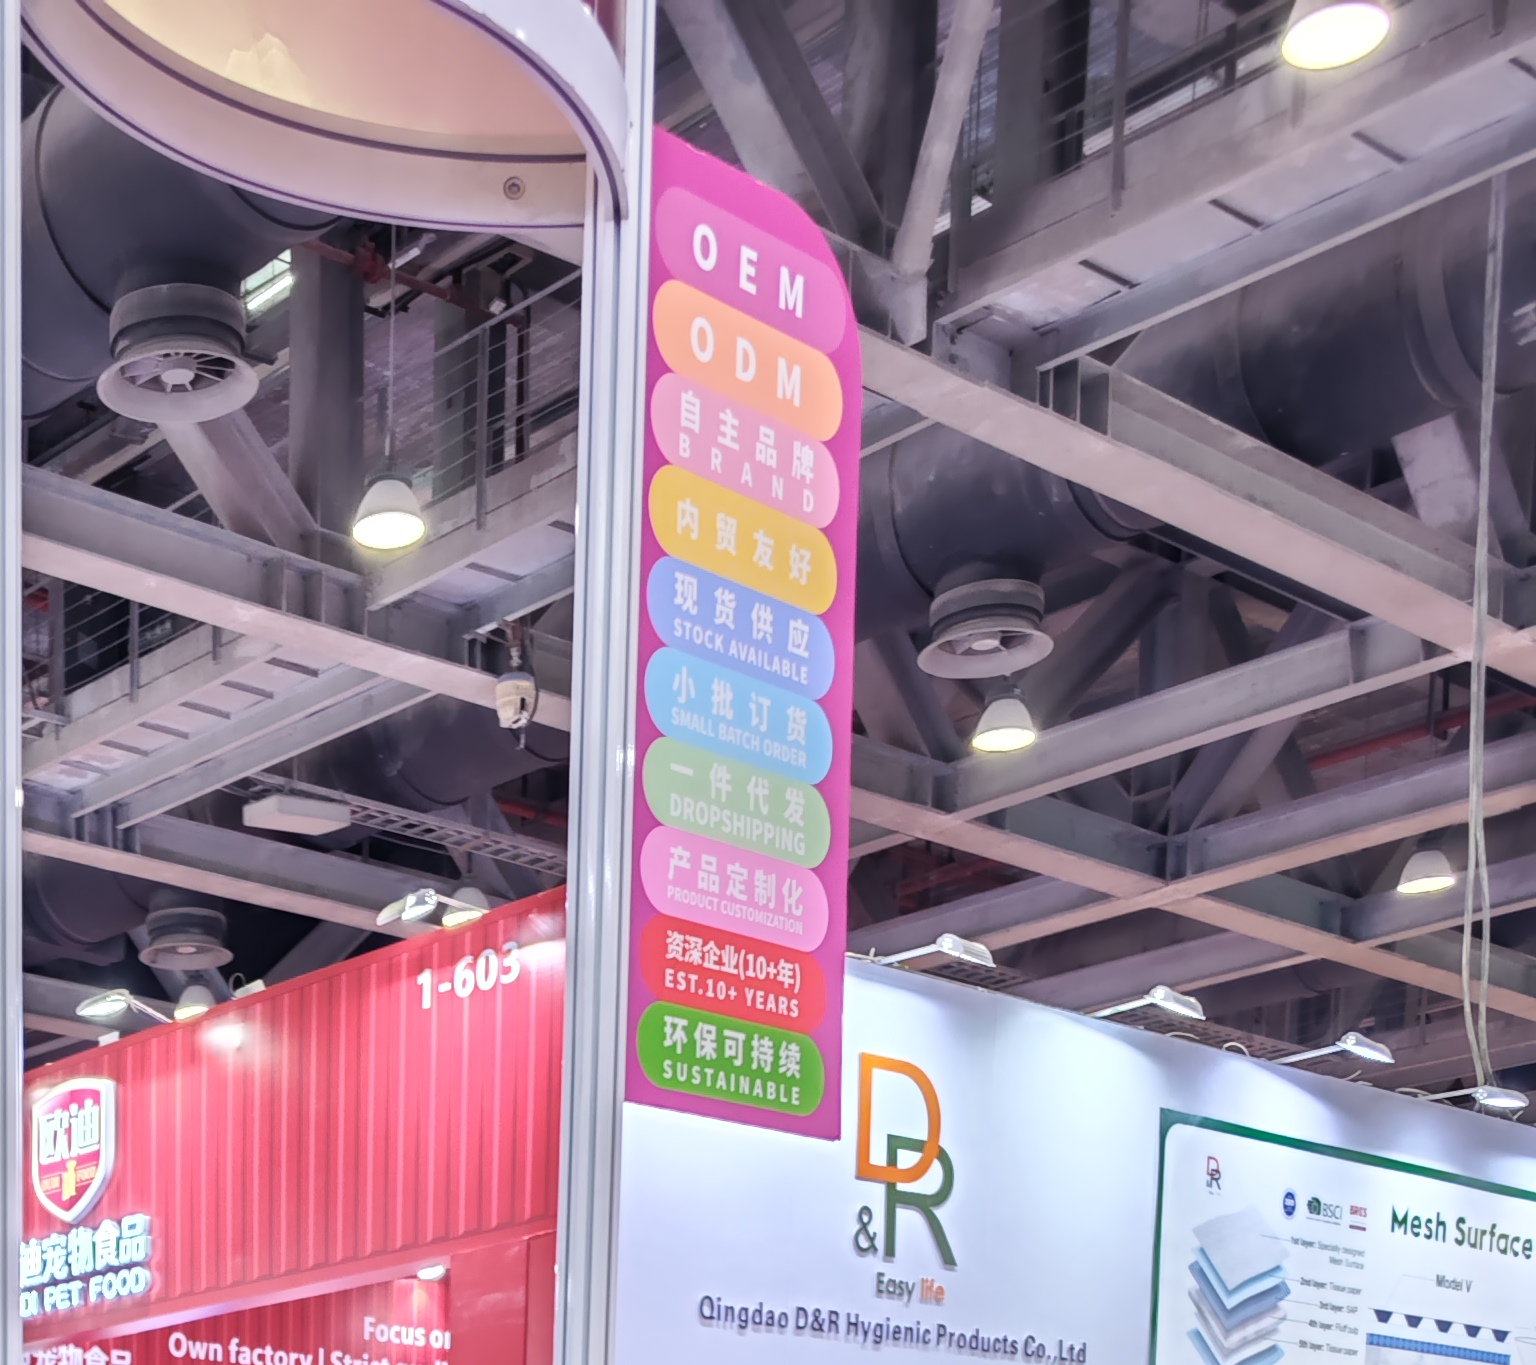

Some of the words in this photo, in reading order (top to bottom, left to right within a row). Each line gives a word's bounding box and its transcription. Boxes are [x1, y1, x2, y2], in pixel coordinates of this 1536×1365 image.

[692, 223, 805, 319] OEM
[690, 316, 802, 407] ODM
[679, 390, 815, 485] 自主品牌
[677, 431, 815, 514] BRAND
[676, 497, 812, 587] 内贸友好
[673, 571, 811, 659] 现货供应
[673, 618, 725, 660] STOCK
[728, 638, 809, 685] AVAILABLE
[671, 665, 808, 747] 小批订货
[671, 706, 716, 739] SMALL
[718, 721, 760, 754] BATCH
[763, 738, 807, 769] ORDER
[669, 761, 806, 828] 一件代发
[669, 792, 806, 856] DROPSHIPPING
[666, 885, 718, 913] PRODUCT
[720, 898, 804, 936] CUSTOMIZATION
[667, 845, 804, 916] 产品定制化
[416, 940, 522, 1010] 1-603
[664, 967, 738, 1002] EST.10+
[744, 983, 800, 1019] YEARS
[663, 1014, 803, 1080] 环保可持续
[662, 1058, 801, 1107] SUSTAINABLE
[39, 1098, 100, 1166] 欧迪
[1322, 1202, 1343, 1221] BSCI
[1391, 1205, 1446, 1243] Mesh
[1455, 1217, 1533, 1261] Surface
[44, 1282, 83, 1313] PET
[89, 1267, 147, 1303] FOOD
[875, 1271, 916, 1304] Easy
[919, 1276, 946, 1304] life
[1435, 1274, 1463, 1293] Model
[1465, 1280, 1473, 1294] V
[168, 1332, 223, 1362] Own
[364, 1316, 426, 1348] Focus
[699, 1295, 790, 1331] Qingdao
[795, 1306, 840, 1334] D&R
[846, 1312, 932, 1345] Hygienic
[936, 1324, 1019, 1357] Products
